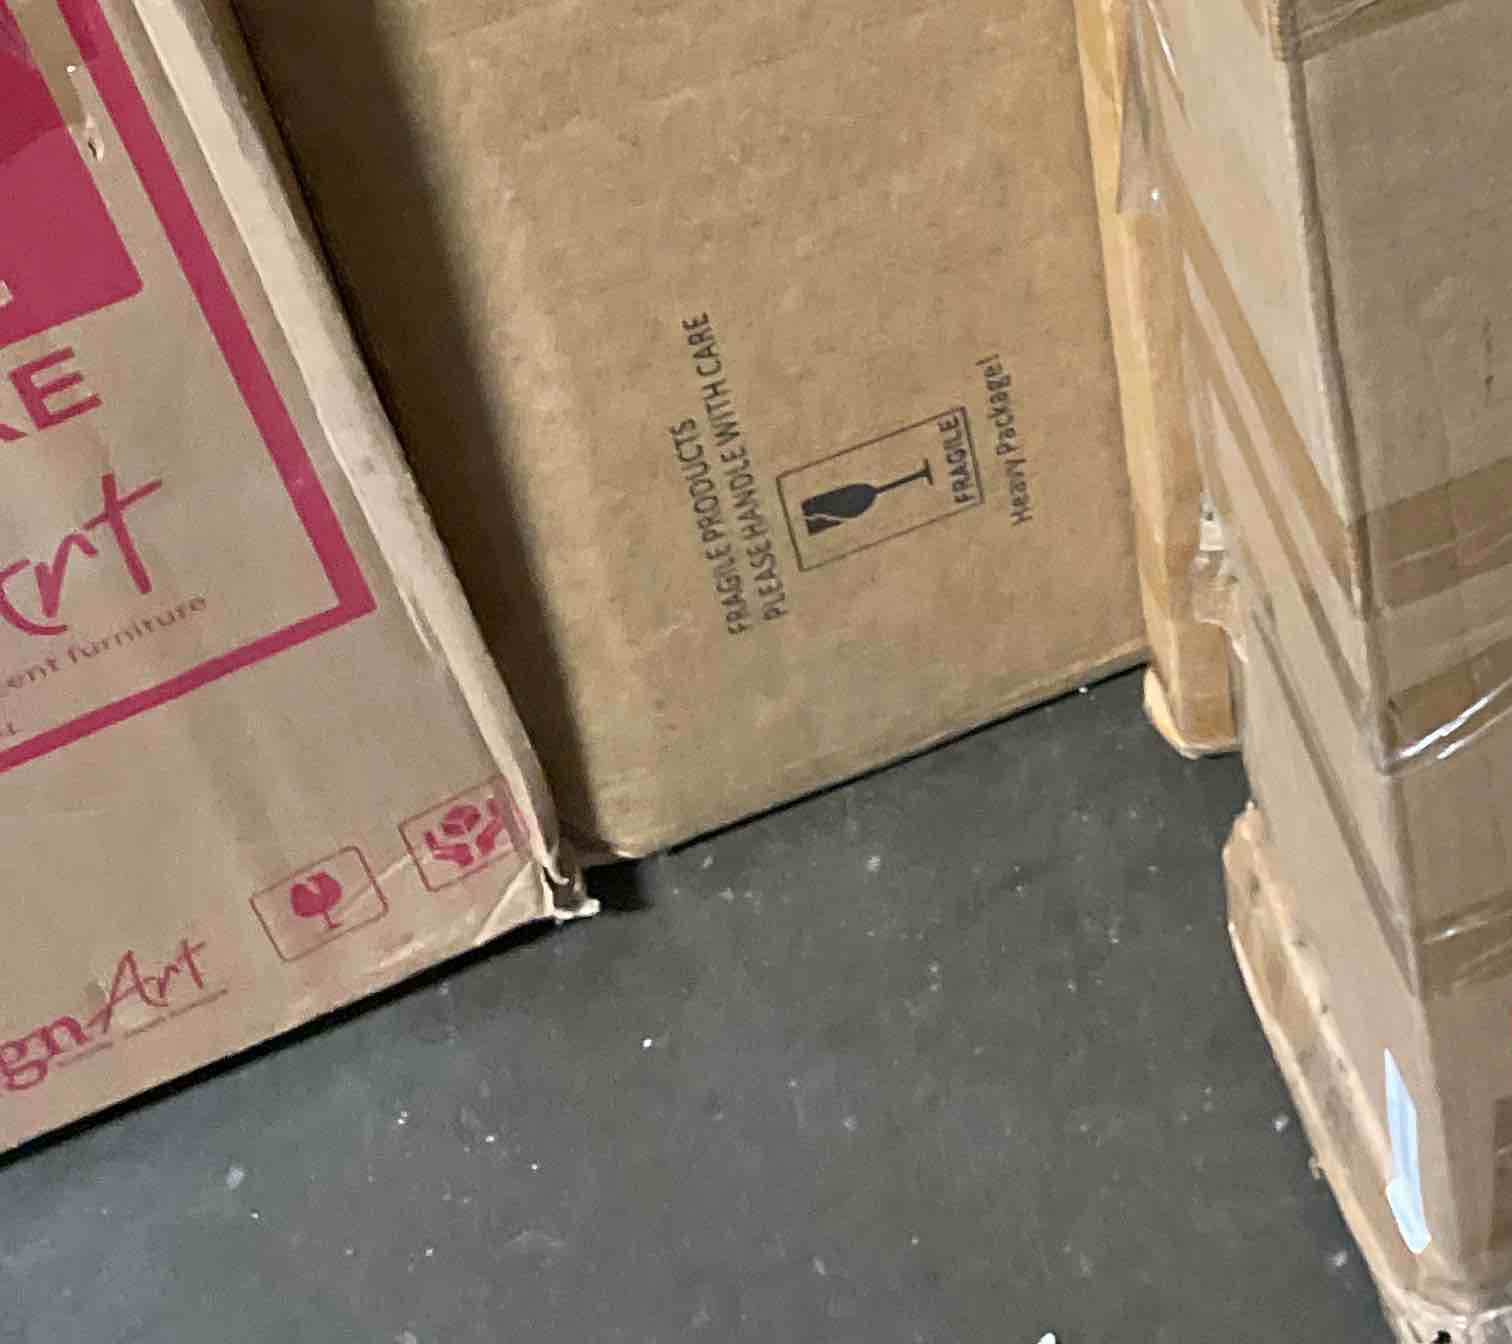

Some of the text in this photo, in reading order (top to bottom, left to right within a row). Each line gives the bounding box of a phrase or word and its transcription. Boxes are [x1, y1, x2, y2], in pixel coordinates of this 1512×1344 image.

[669, 416, 754, 636] FRAGILE PRODUCTS
[682, 311, 790, 623] PLEASE HANDLE WITH CARE
[935, 413, 975, 505] FRAGILE
[974, 351, 1034, 528] Heavy Package!
[67, 596, 207, 664] furniture
